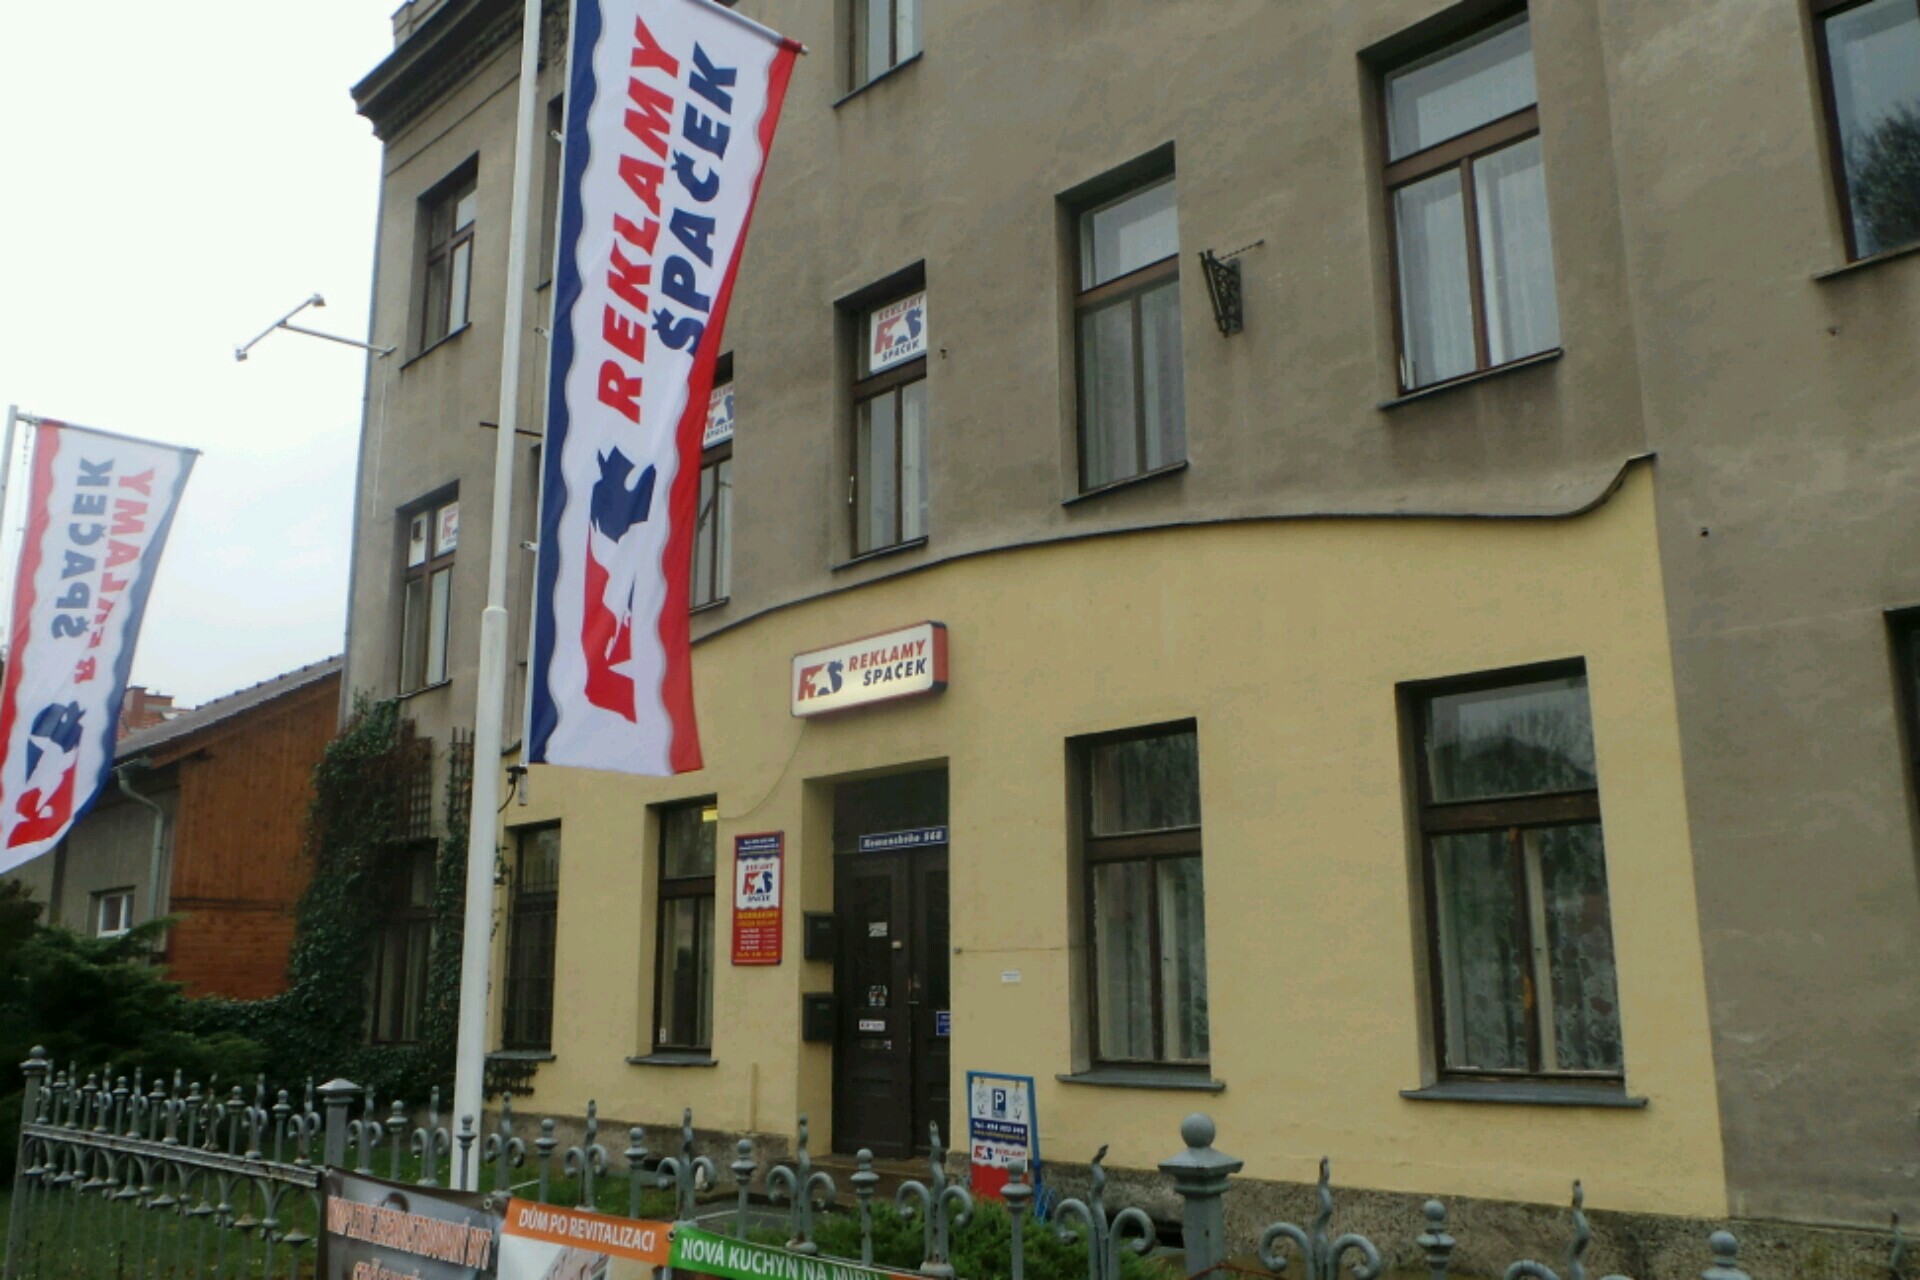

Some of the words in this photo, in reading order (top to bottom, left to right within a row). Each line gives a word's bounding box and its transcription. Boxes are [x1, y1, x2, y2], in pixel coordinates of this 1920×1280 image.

[651, 40, 738, 358] ŠPAČEK
[598, 14, 680, 425] REKLAMY
[848, 638, 927, 672] REKLAMY
[995, 1091, 1005, 1110] P
[518, 1205, 549, 1232] DŮM
[550, 1213, 568, 1235] PO
[568, 1216, 656, 1252] REVITALIZACI
[680, 1237, 725, 1268] NOVÁ
